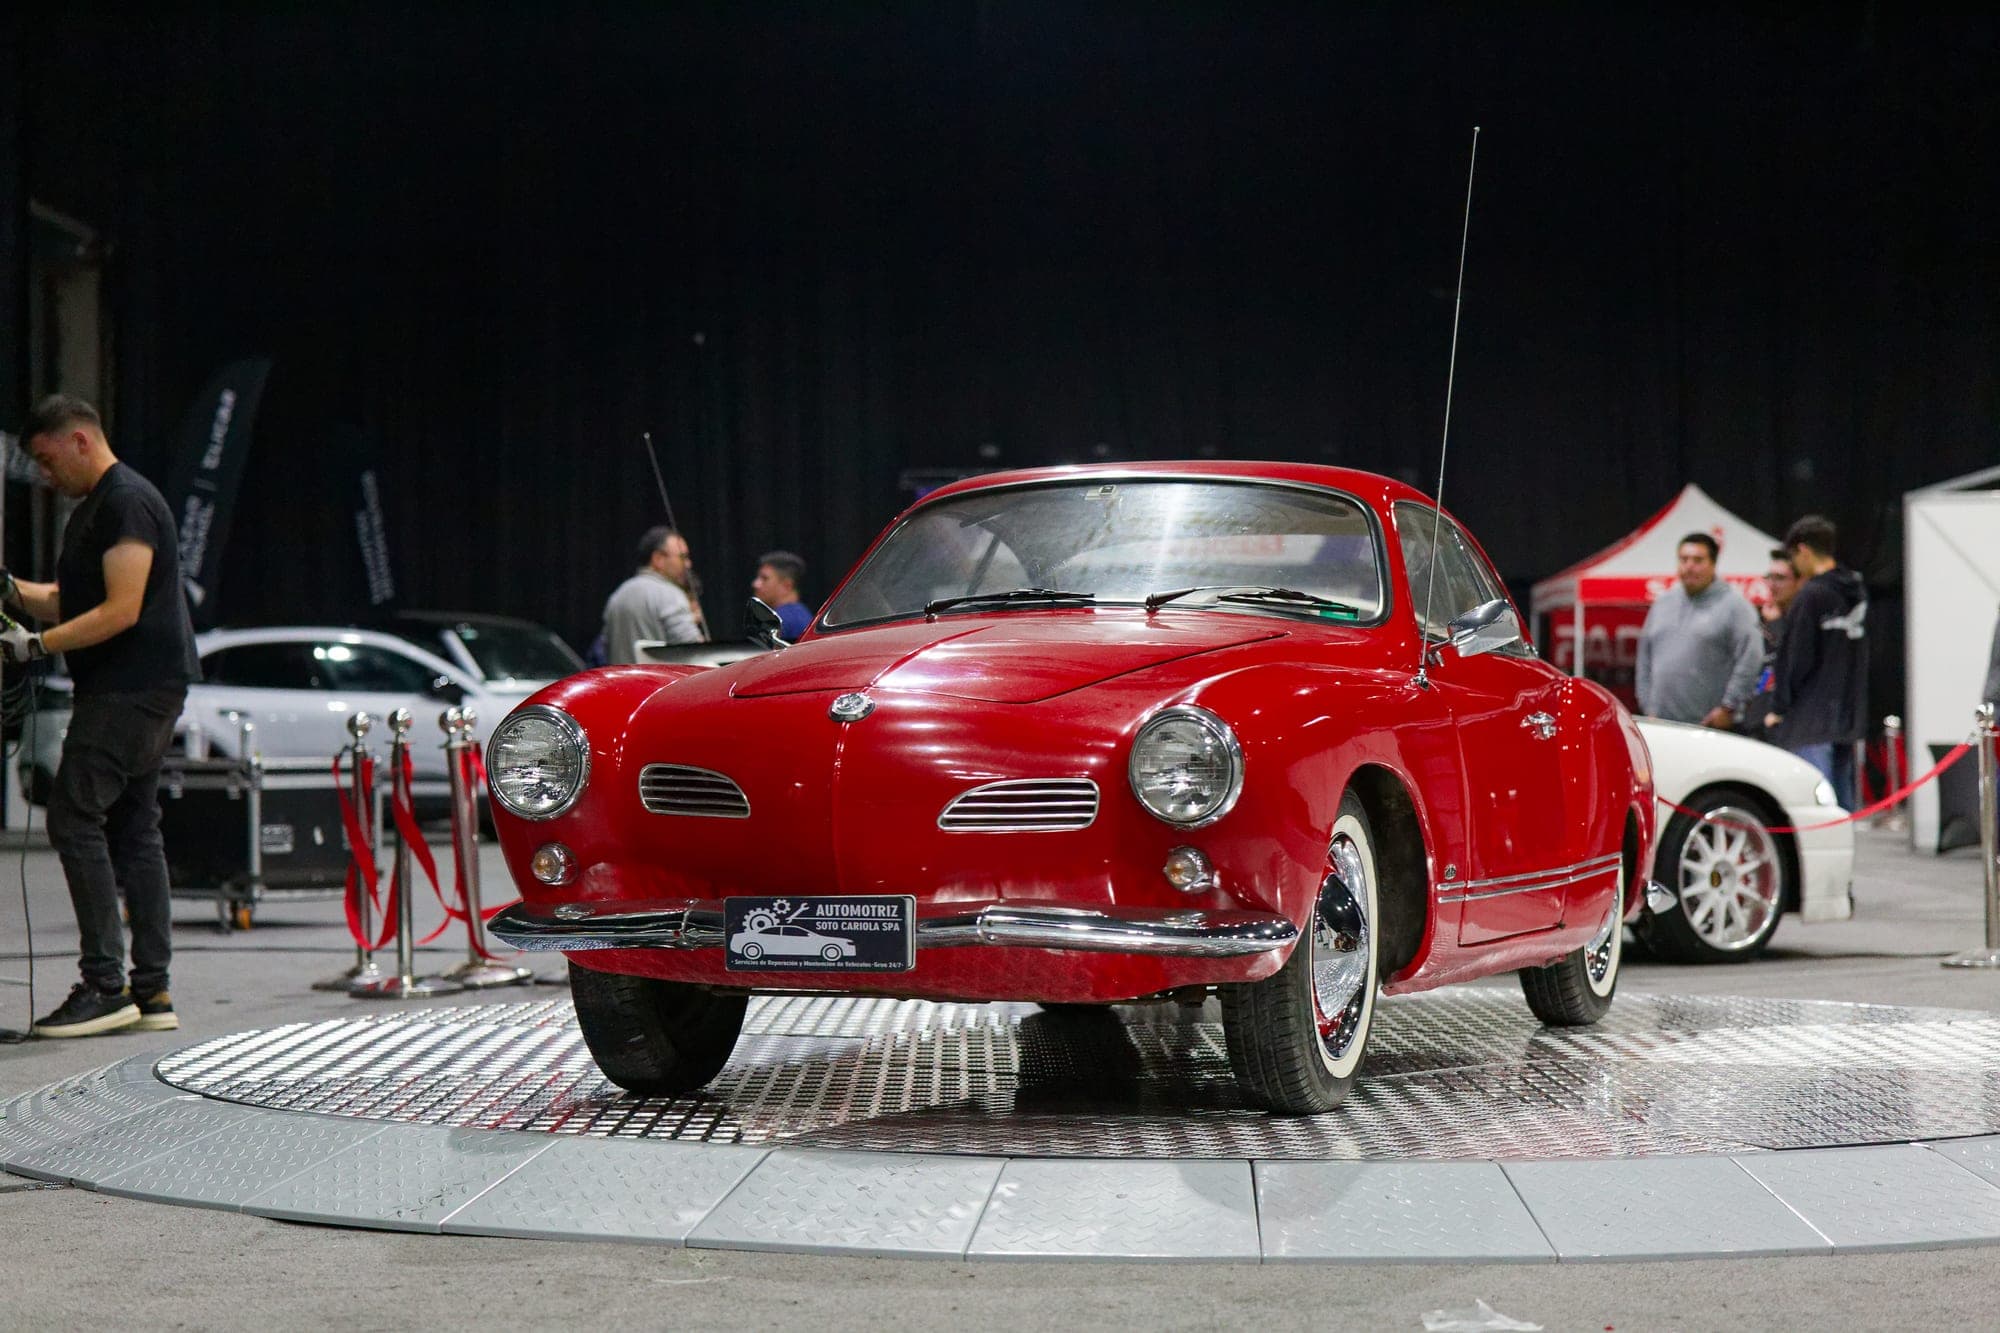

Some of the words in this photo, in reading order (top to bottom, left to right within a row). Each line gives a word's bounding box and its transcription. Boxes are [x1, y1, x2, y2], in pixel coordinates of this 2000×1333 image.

[815, 904, 899, 917] AUTOMOTRIZ
[815, 921, 839, 931] SOTO
[840, 922, 880, 931] CARIOLA
[881, 922, 900, 931] SPA
